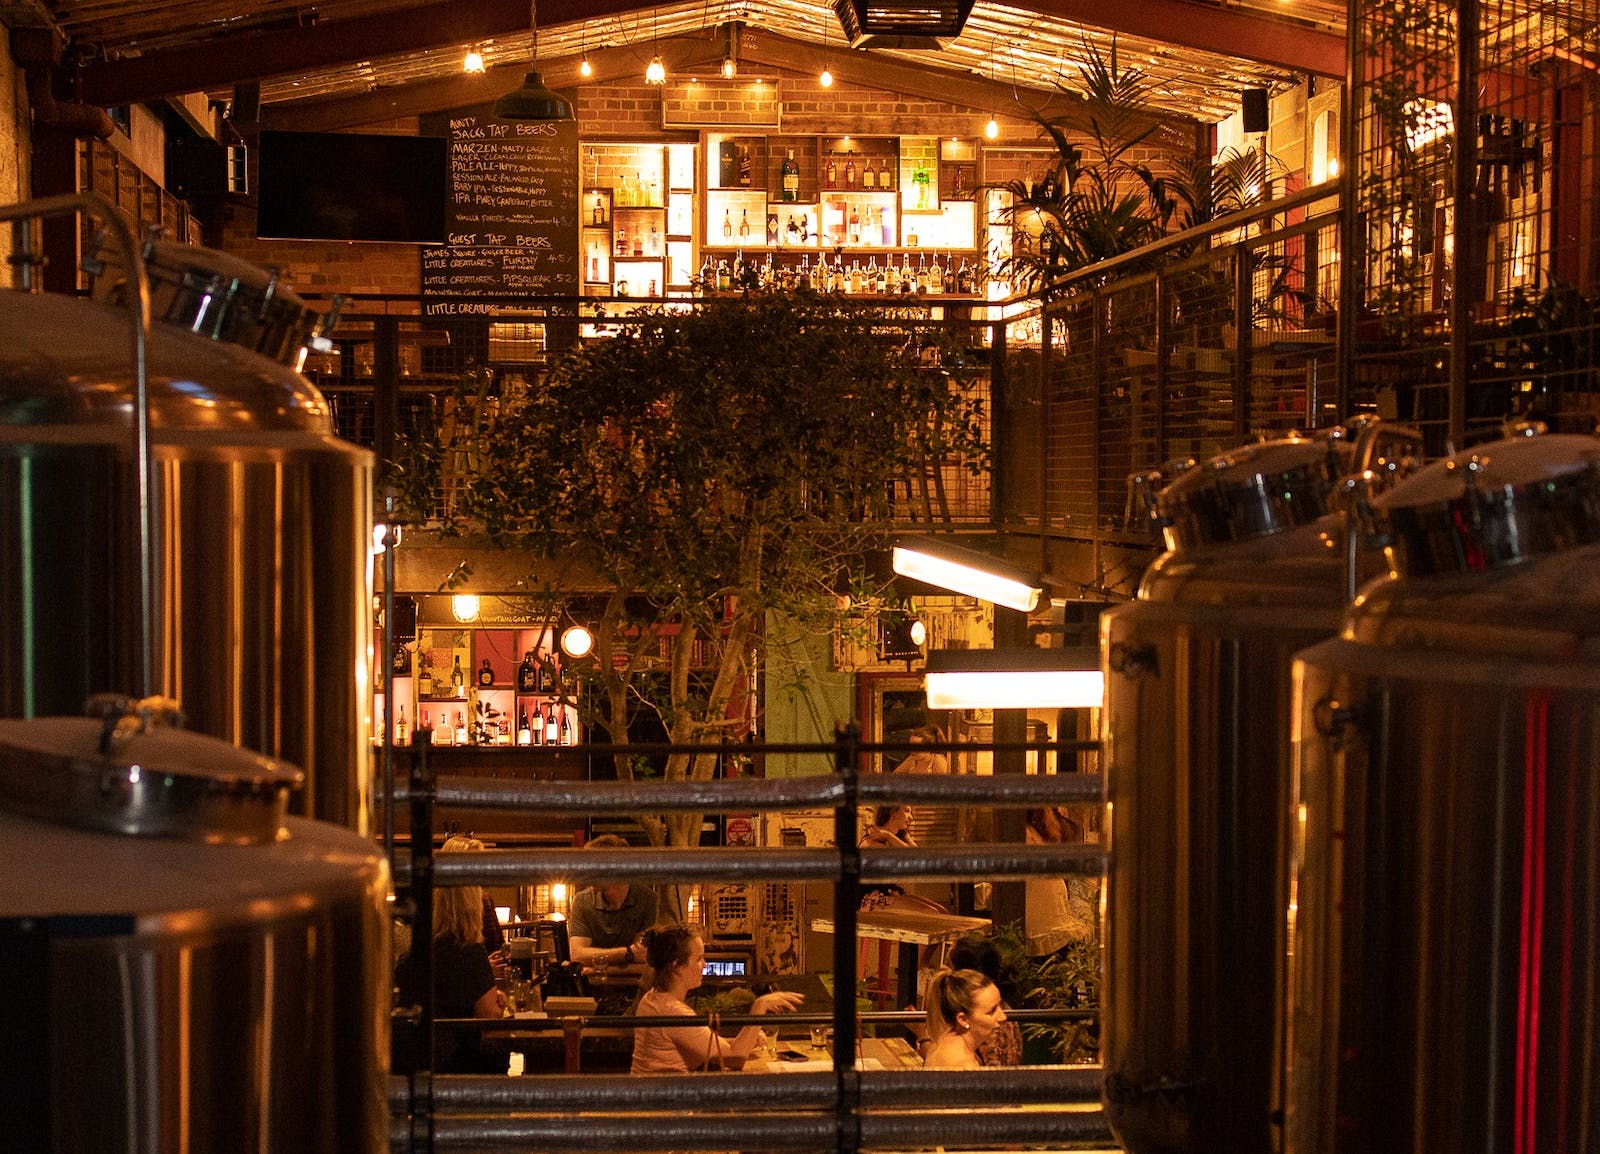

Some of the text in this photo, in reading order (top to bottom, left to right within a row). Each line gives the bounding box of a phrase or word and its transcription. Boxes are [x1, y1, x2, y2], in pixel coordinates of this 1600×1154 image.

[487, 124, 509, 137] TAP
[516, 124, 558, 136] BEERS
[452, 144, 497, 154] MARZEN
[452, 154, 480, 162] LAGER
[452, 162, 475, 172] PALE
[476, 162, 495, 171] ALE
[452, 173, 483, 182] SESSION
[454, 182, 472, 191] BABY
[474, 184, 488, 193] IPA
[455, 192, 471, 204] IPA
[448, 232, 552, 248] GUEST TAP BEERS
[424, 249, 449, 258] JAMES
[424, 260, 447, 269] LITTLE
[450, 258, 495, 268] CREATURES
[425, 276, 447, 284] LITTLE
[450, 276, 496, 284] CREATURES
[427, 303, 456, 315] LITTLE
